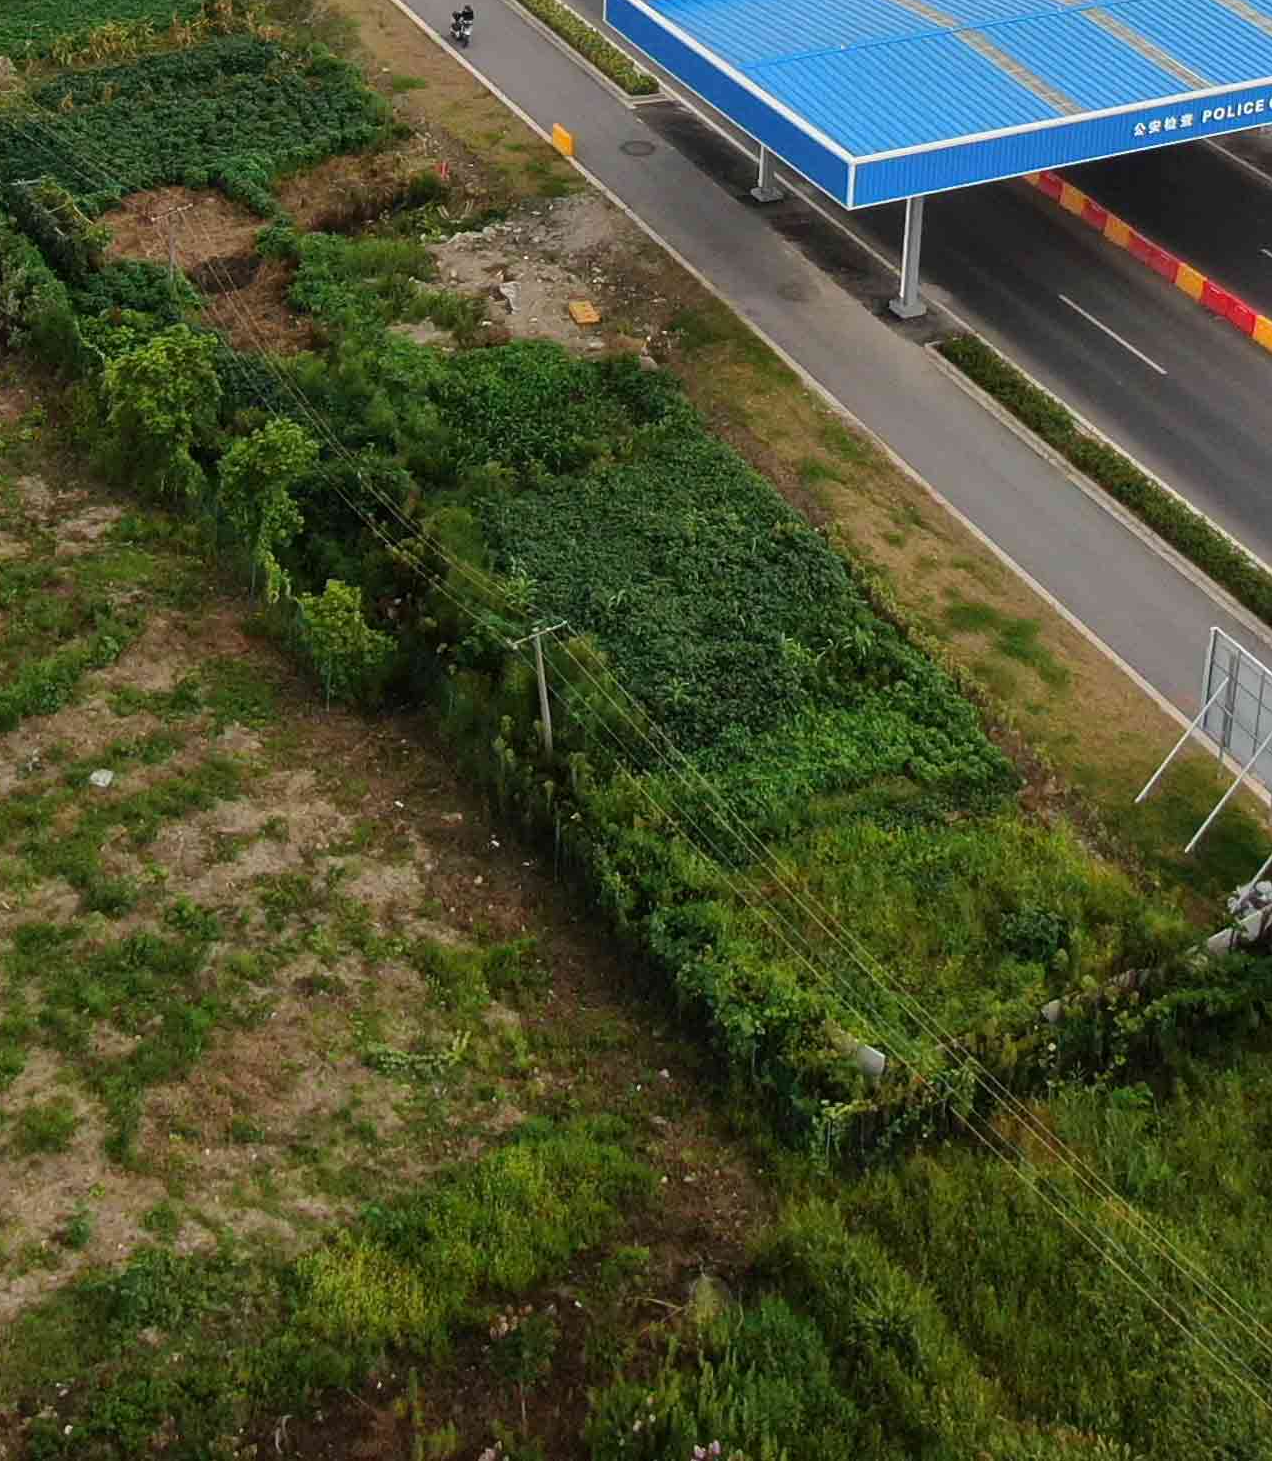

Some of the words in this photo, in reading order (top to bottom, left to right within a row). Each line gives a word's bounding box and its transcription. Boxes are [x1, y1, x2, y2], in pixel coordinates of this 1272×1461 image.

[1133, 113, 1194, 137] 公安检查
[1202, 99, 1265, 124] POLICE
